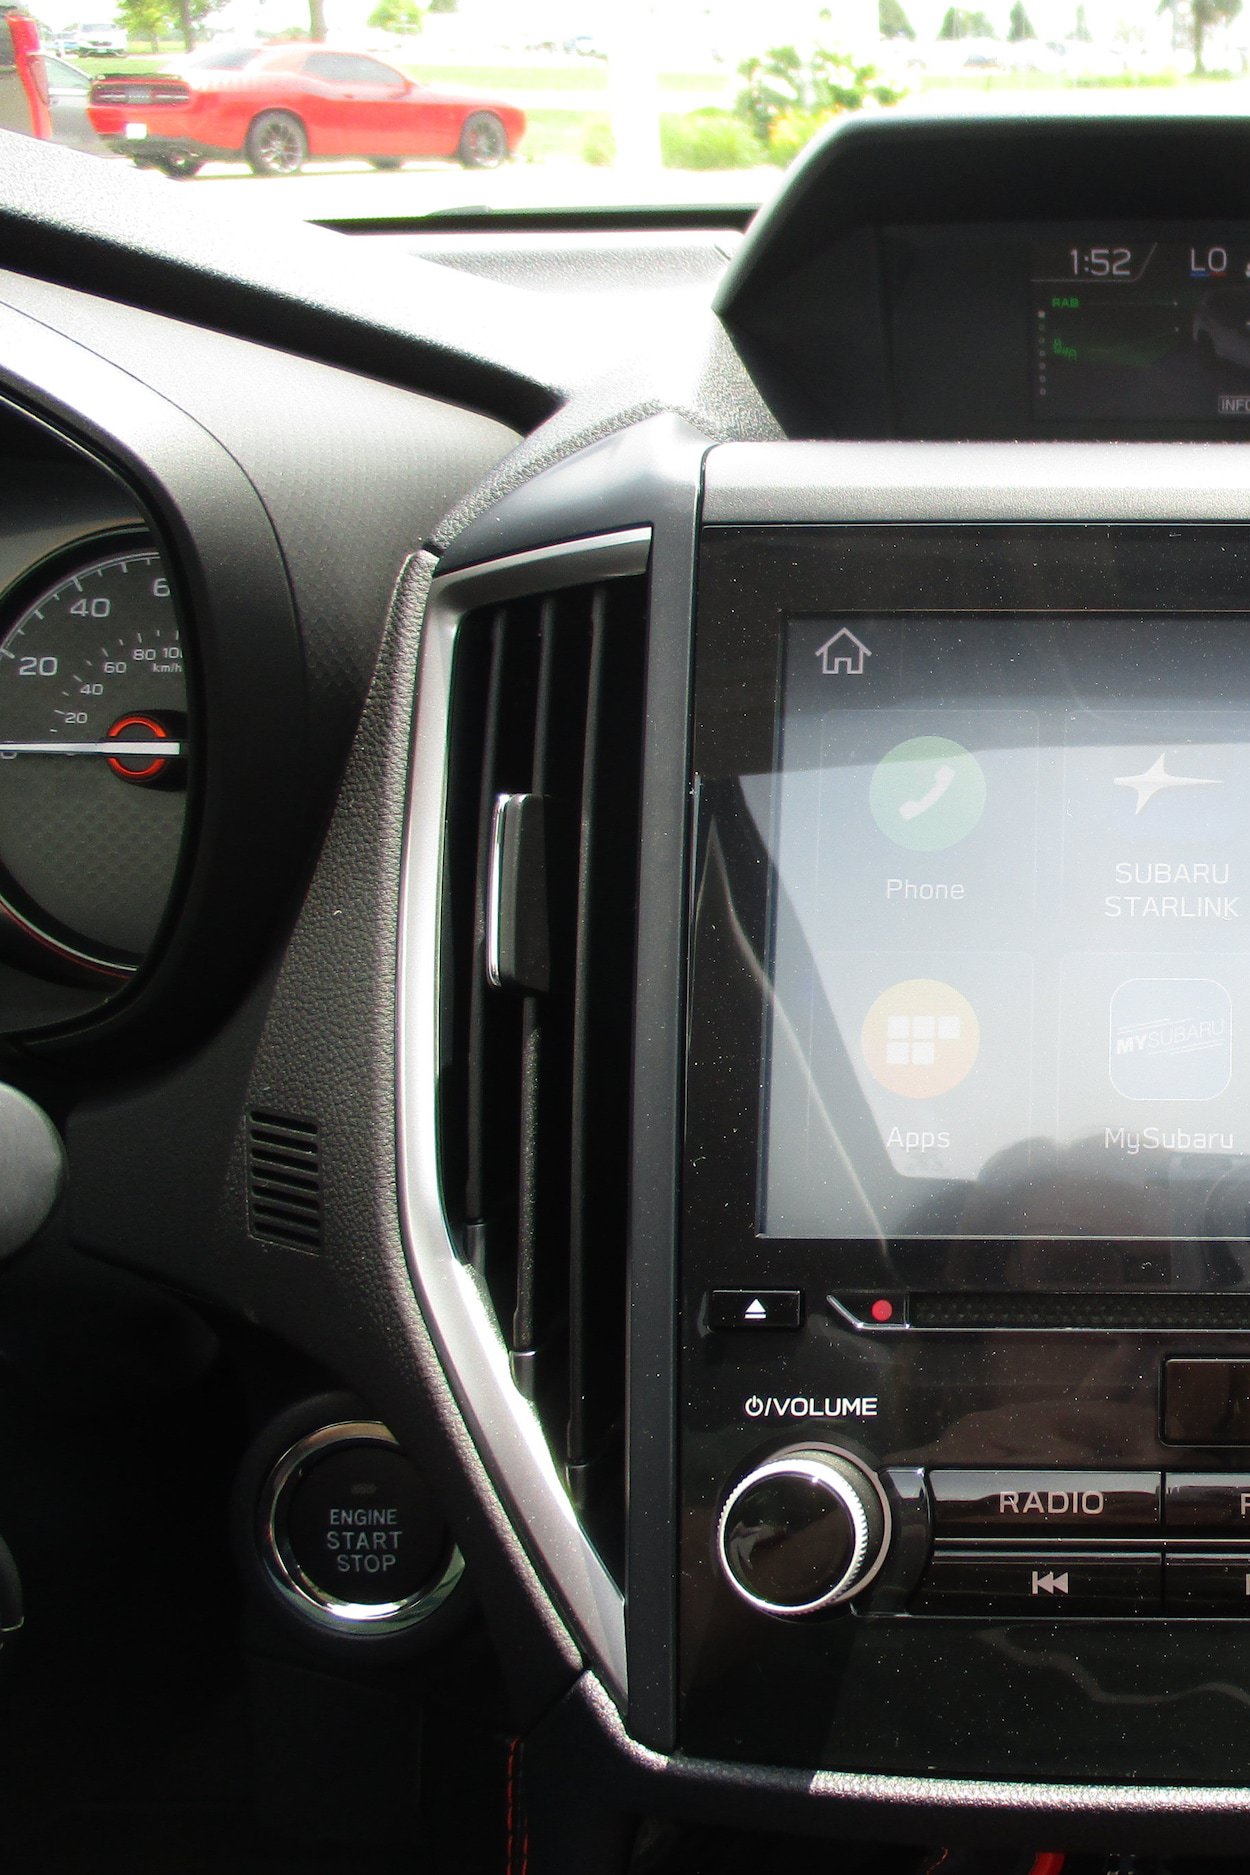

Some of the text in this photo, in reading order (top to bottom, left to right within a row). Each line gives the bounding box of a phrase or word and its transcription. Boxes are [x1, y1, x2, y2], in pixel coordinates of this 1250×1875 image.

[1070, 247, 1132, 277] 1:52
[1190, 246, 1228, 273] LO
[69, 598, 111, 618] 40
[132, 647, 183, 661] 80 10
[19, 656, 58, 676] 20
[103, 661, 183, 674] 60 km/h
[79, 683, 104, 695] 40
[64, 712, 88, 724] 20
[1115, 861, 1231, 885] SUBARU
[886, 878, 965, 901] Phone
[1104, 896, 1240, 918] STARLINK
[885, 1126, 951, 1154] Apps
[1104, 1126, 1234, 1155] MySubaru
[999, 1490, 1104, 1515] RADIO
[329, 1508, 398, 1526] ENGINE
[326, 1530, 403, 1550] START
[336, 1554, 396, 1573] STOP
